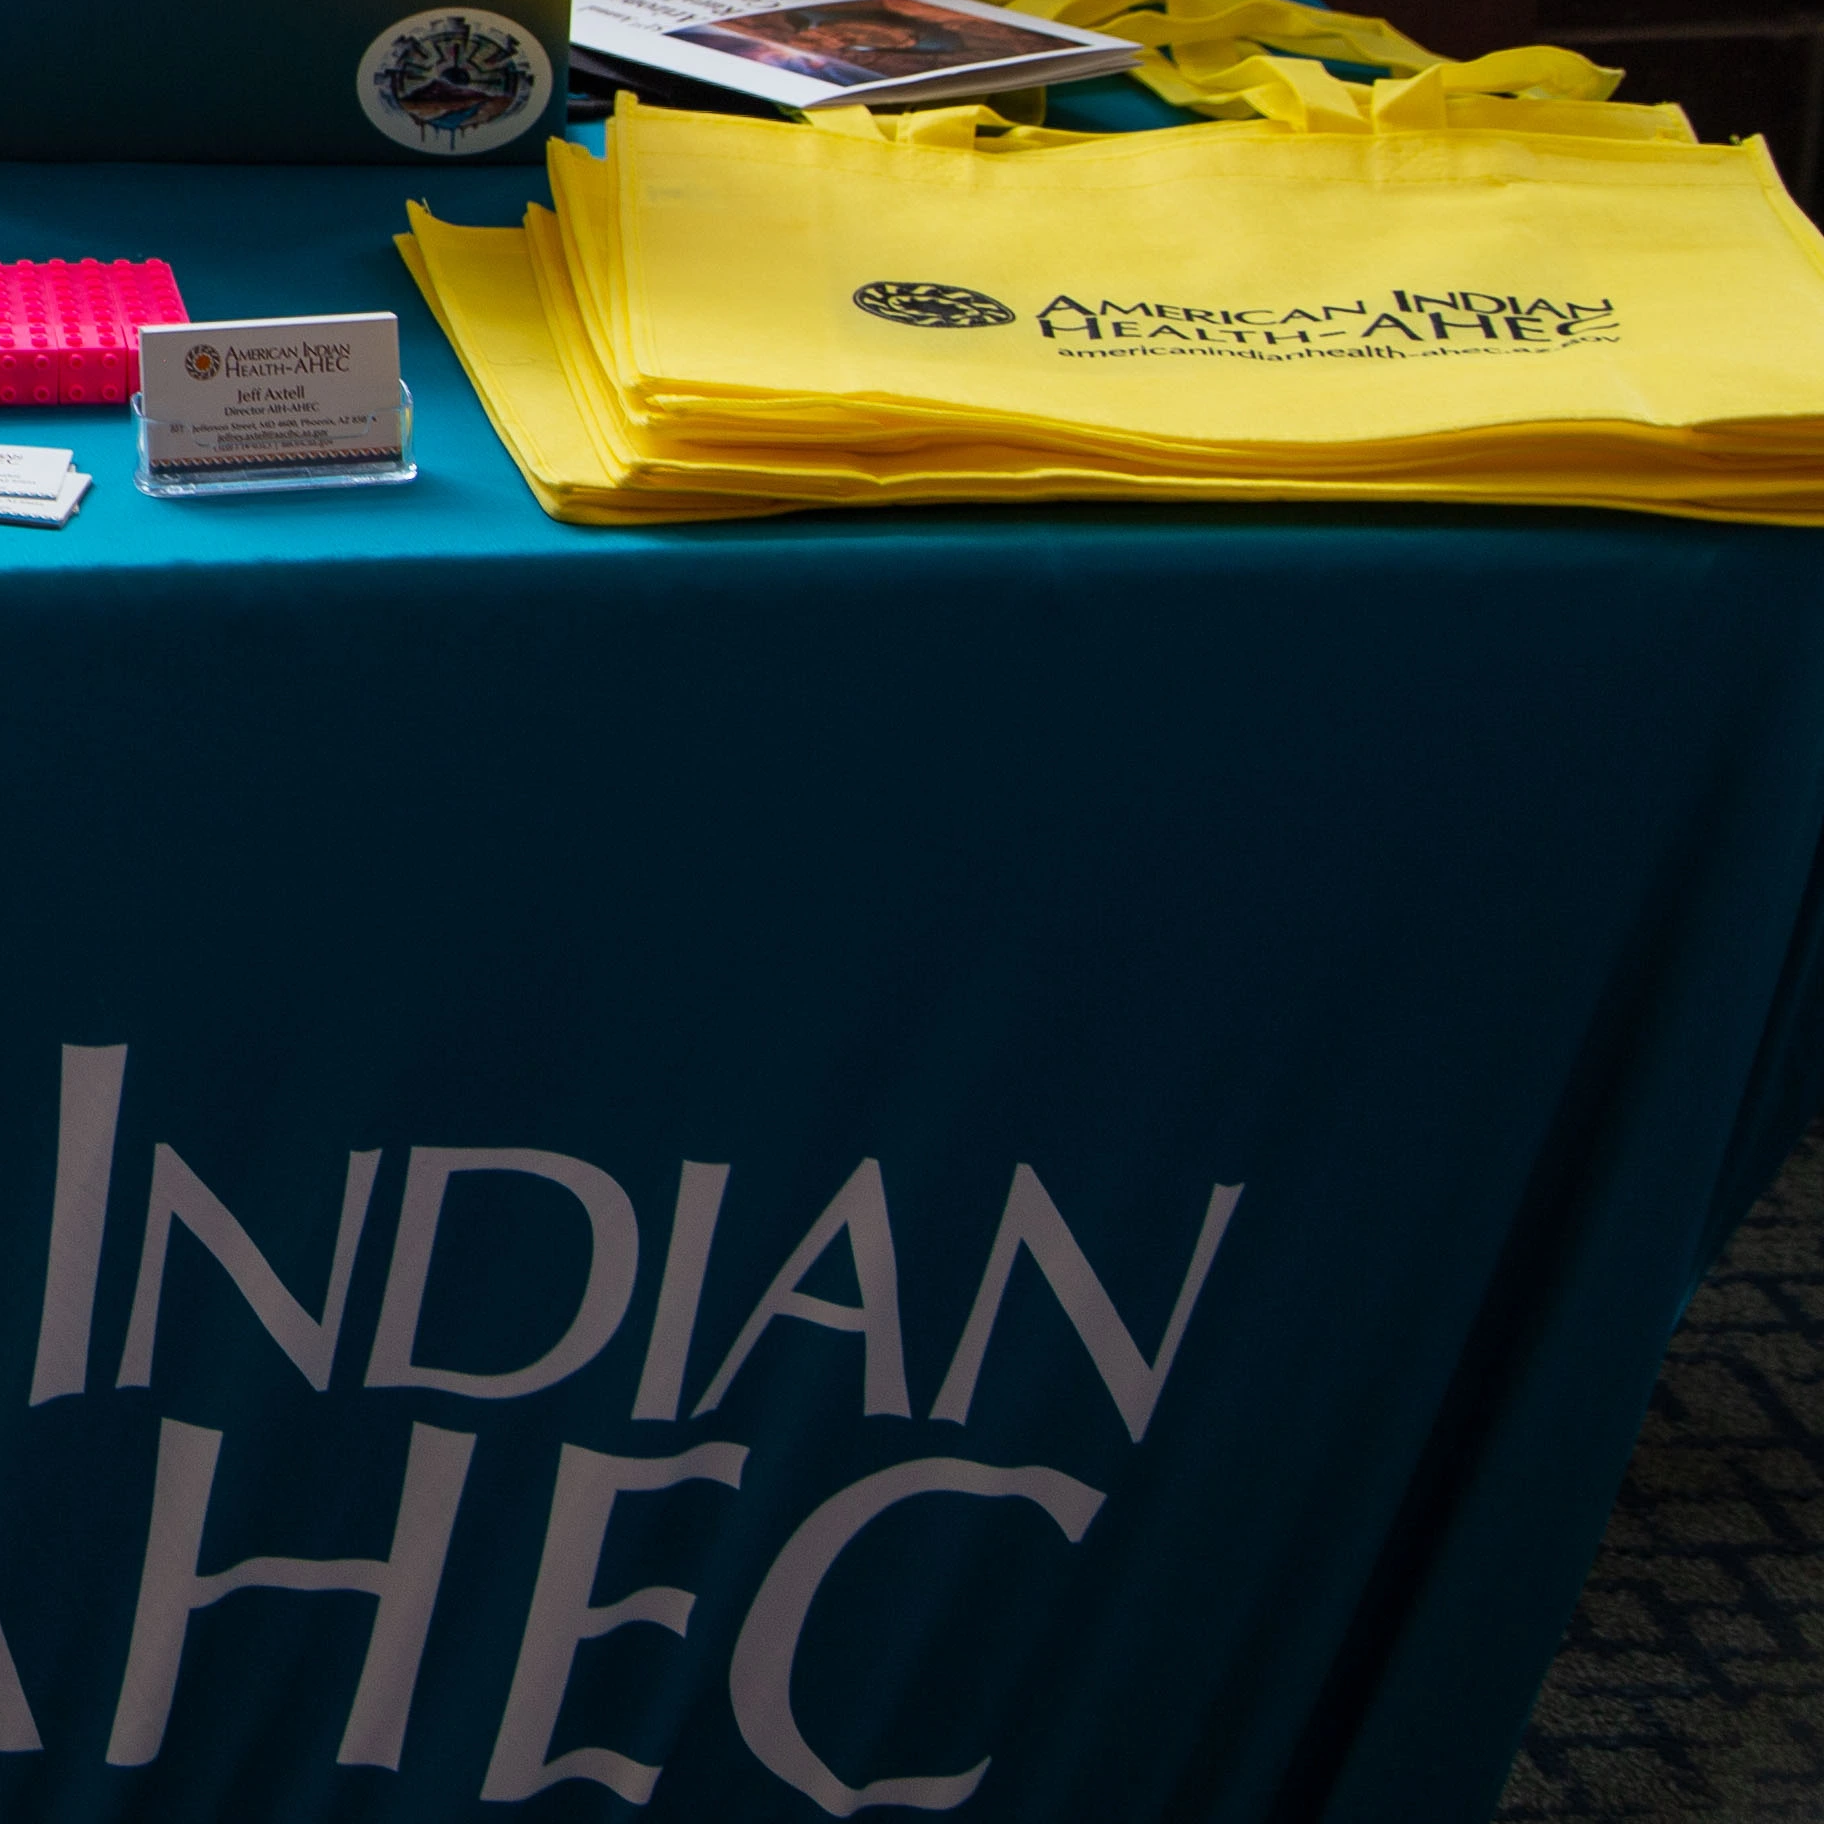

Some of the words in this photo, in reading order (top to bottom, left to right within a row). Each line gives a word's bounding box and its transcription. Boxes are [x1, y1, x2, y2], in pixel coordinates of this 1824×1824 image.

[1035, 294, 1368, 327] AMERICAN
[1392, 289, 1615, 320] INDIAN
[1039, 311, 1621, 346] HEALTH-AHEC
[224, 345, 299, 361] AMERICAN
[302, 340, 352, 358] INDIAN
[224, 356, 351, 378] HEALTH-AHEC
[237, 386, 263, 404] Jeff
[265, 384, 306, 401] Axtell
[224, 405, 265, 417] Director
[25, 1042, 1245, 1446] INDIAN
